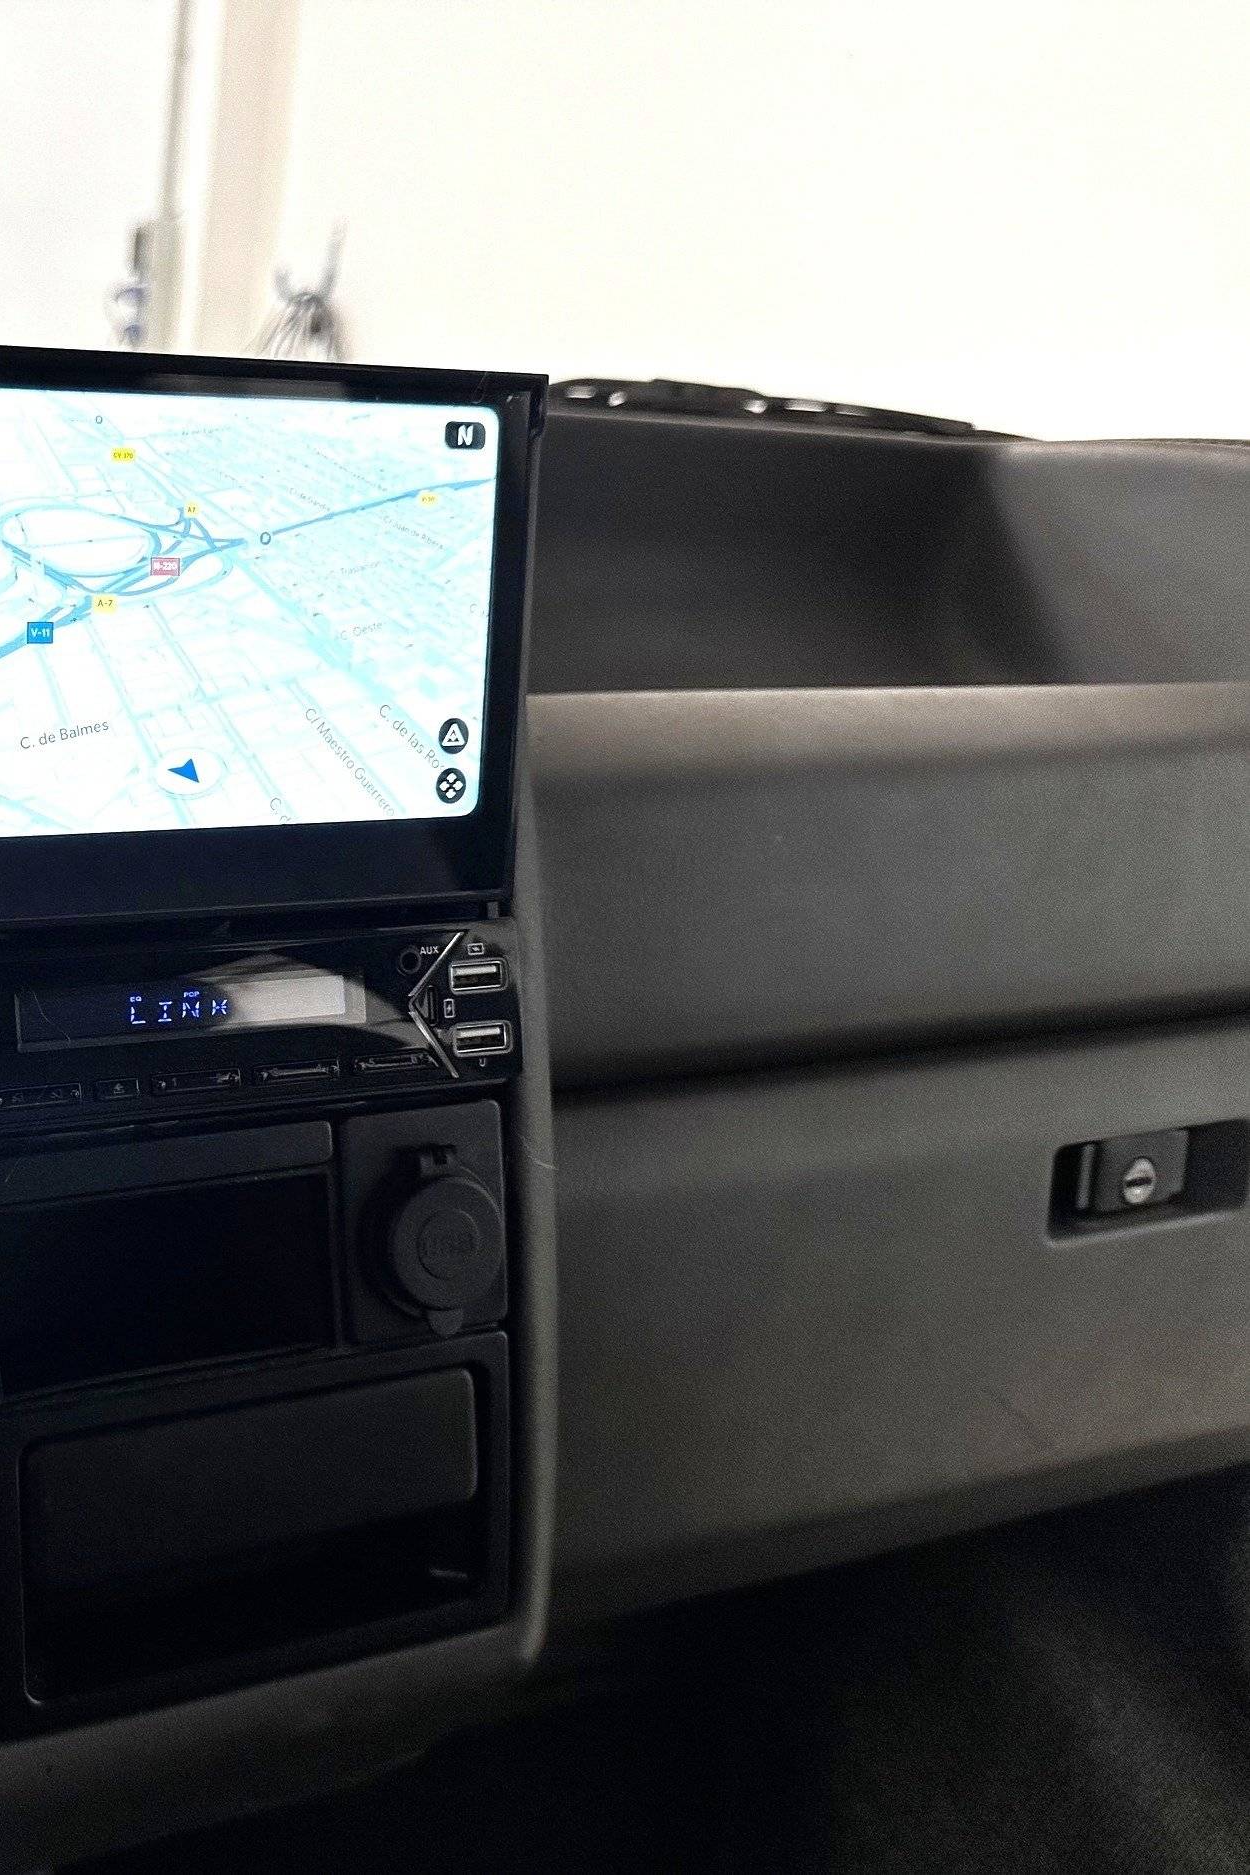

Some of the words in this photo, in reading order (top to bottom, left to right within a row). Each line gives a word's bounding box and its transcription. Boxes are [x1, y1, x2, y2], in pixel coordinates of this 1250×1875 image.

[457, 425, 474, 447] N
[97, 599, 113, 607] A-7
[30, 626, 51, 639] V-11
[20, 736, 35, 751] C.
[39, 730, 56, 745] de
[59, 720, 110, 742] Balmes
[379, 705, 391, 722] C.
[393, 719, 408, 737] de
[408, 733, 424, 754] las
[424, 749, 445, 769] Ro
[305, 708, 318, 724] C/
[316, 721, 355, 769] Maestro
[354, 767, 395, 817] Guerrero
[419, 945, 440, 955] AUX
[130, 999, 228, 1025] LINK
